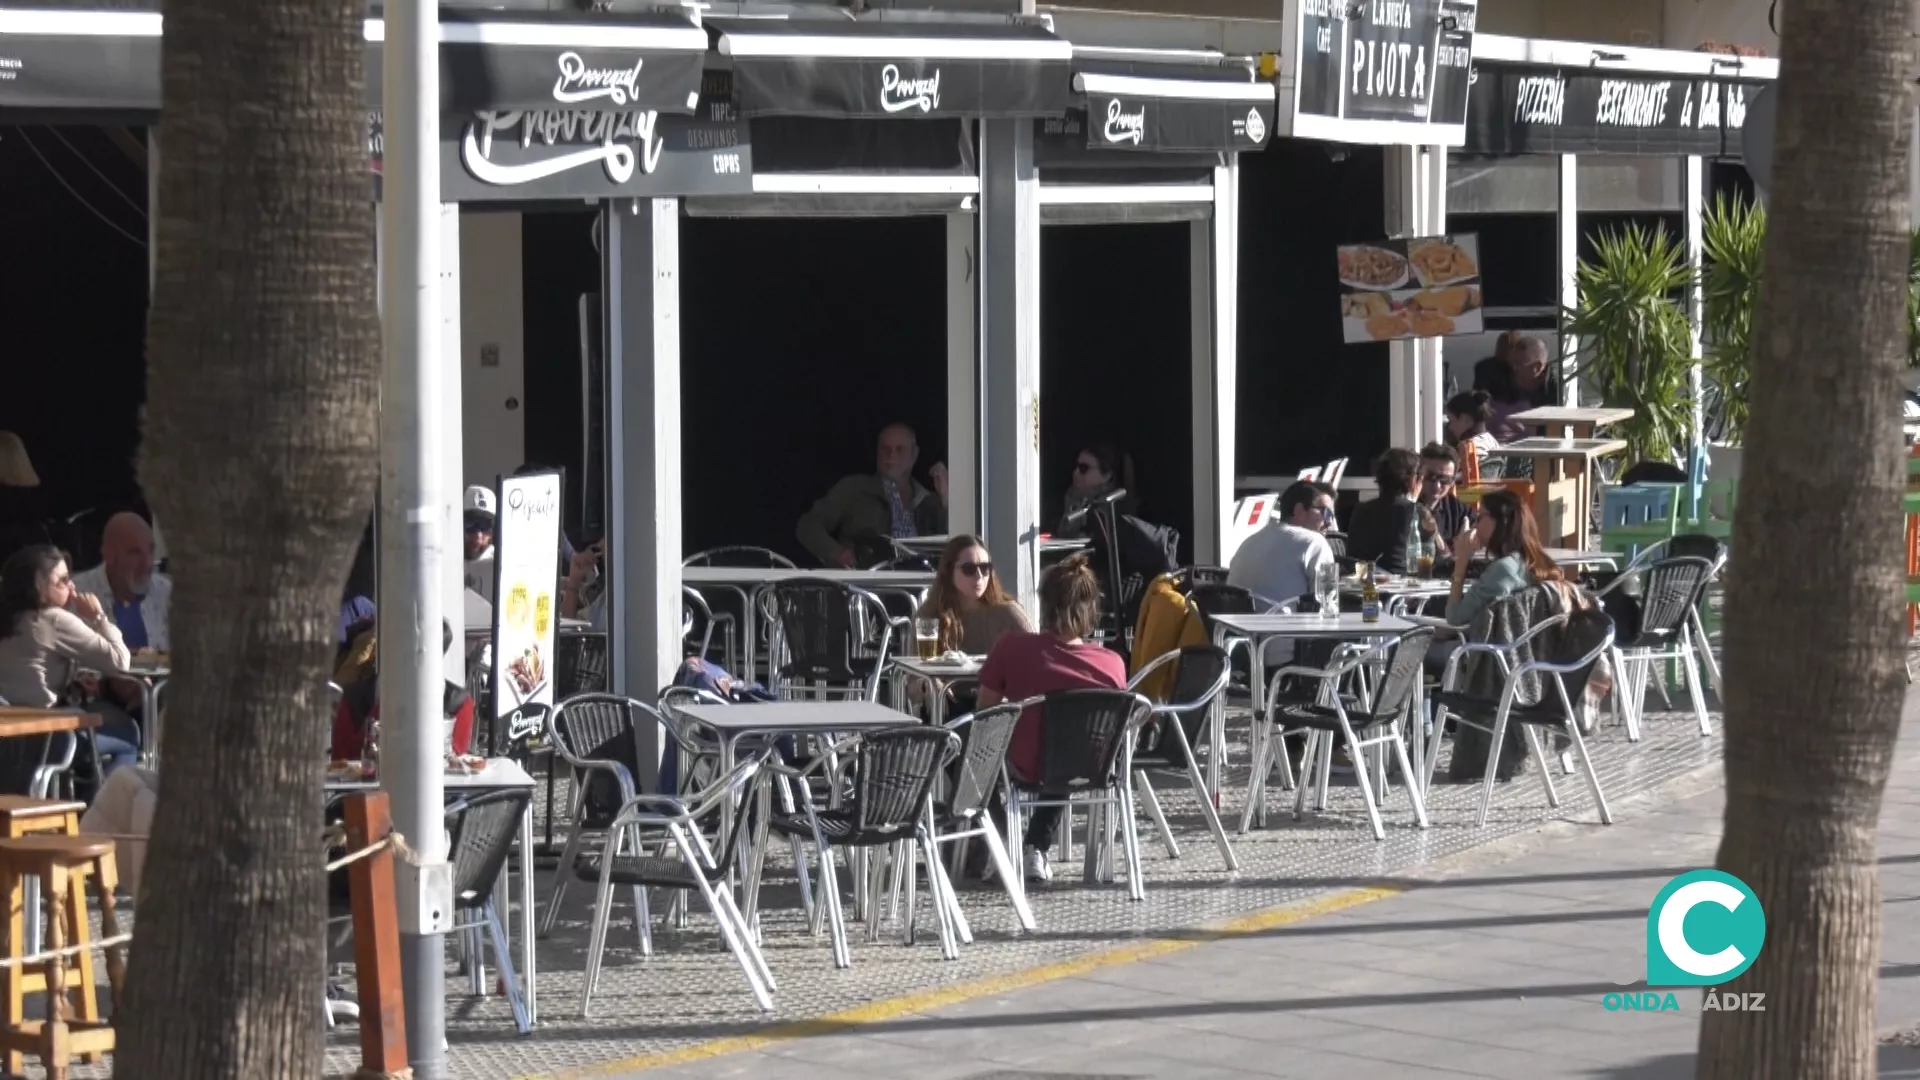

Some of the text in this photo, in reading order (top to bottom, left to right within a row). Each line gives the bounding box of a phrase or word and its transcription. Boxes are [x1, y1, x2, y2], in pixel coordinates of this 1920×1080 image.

[552, 52, 643, 104] Provenzal
[1352, 40, 1426, 99] PIJOTA
[1514, 68, 1566, 125] PIZZERÍA
[1596, 80, 1671, 127] RESTAURANTE
[687, 129, 738, 149] DESAYUNOS
[713, 154, 740, 174] COPAS
